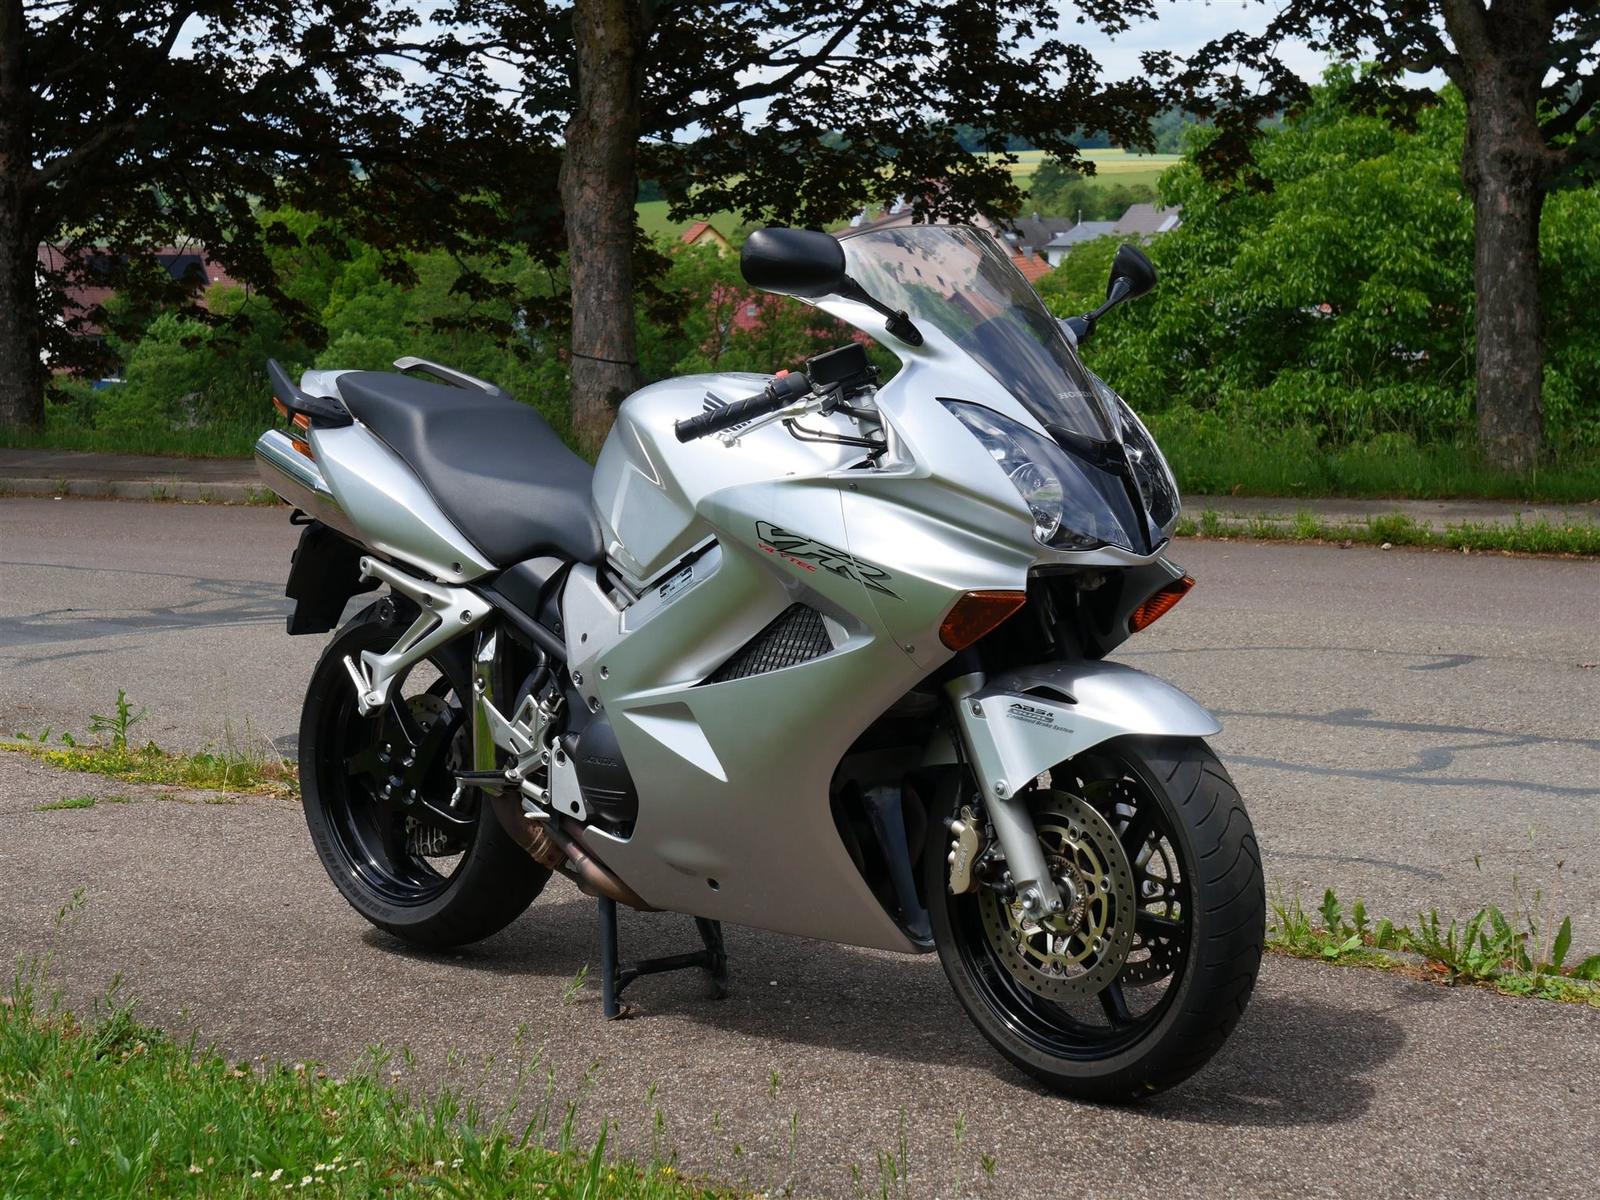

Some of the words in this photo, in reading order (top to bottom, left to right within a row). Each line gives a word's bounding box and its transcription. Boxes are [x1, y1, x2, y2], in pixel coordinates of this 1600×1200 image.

[755, 520, 905, 601] VFR
[780, 550, 817, 574] VTEC
[1010, 703, 1046, 715] ABS
